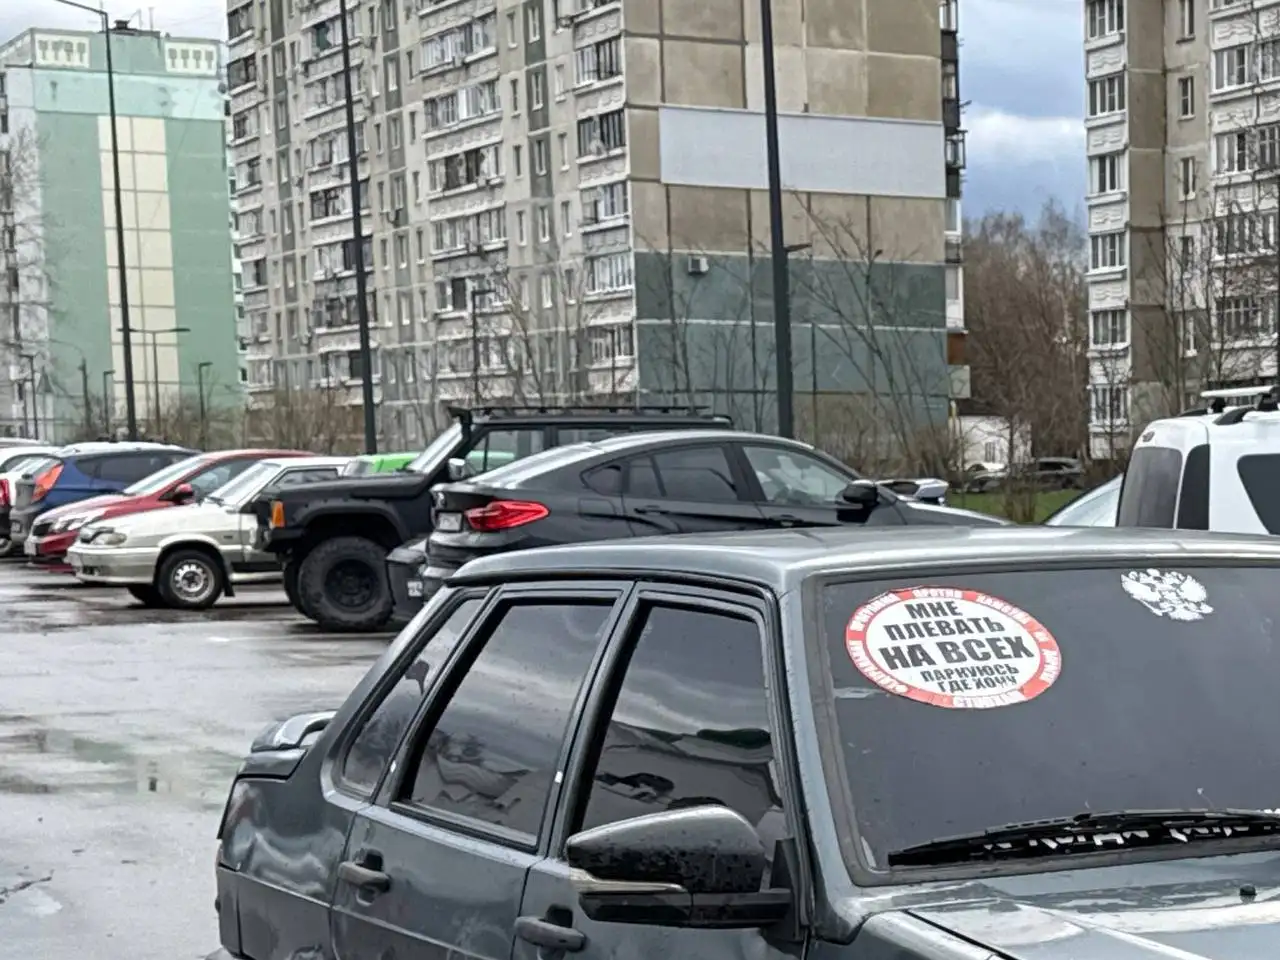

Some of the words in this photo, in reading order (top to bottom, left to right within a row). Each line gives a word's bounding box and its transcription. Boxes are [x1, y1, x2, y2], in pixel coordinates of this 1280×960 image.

[903, 600, 963, 619] МНЕ
[882, 617, 1006, 641] ПЛЕВАТЬ
[878, 643, 937, 671] НА
[936, 636, 1035, 664] ВСЕХ
[920, 663, 1020, 682] ПАРКУЮСЬ
[937, 679, 973, 694] ГДЕ
[972, 675, 1019, 690] ХОЧУ
